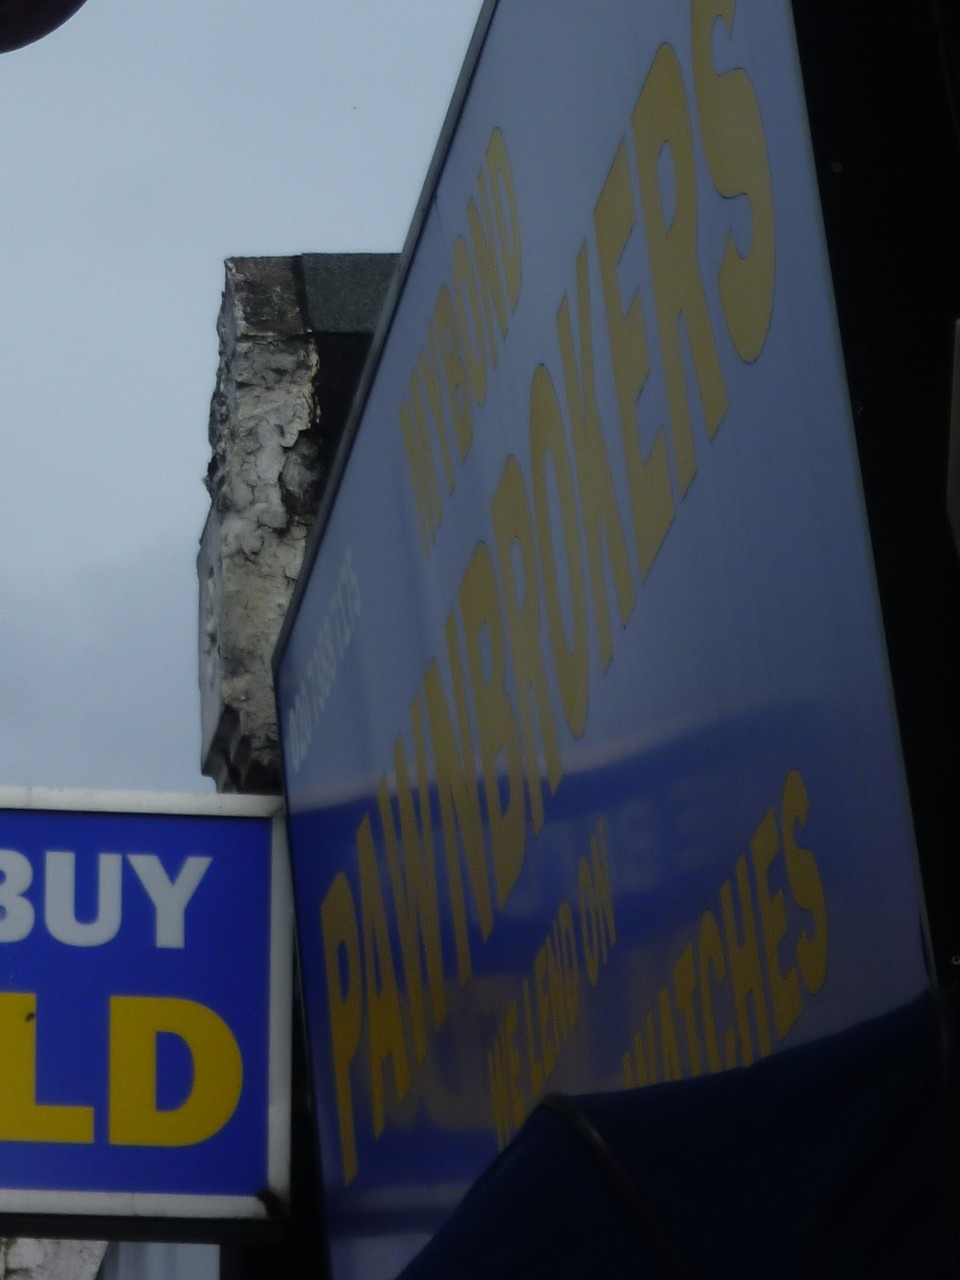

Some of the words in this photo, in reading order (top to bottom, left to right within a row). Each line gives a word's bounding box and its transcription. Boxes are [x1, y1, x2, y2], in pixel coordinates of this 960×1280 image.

[399, 126, 522, 555] MYBOND
[524, 900, 580, 1096] LEND
[578, 815, 617, 987] ON
